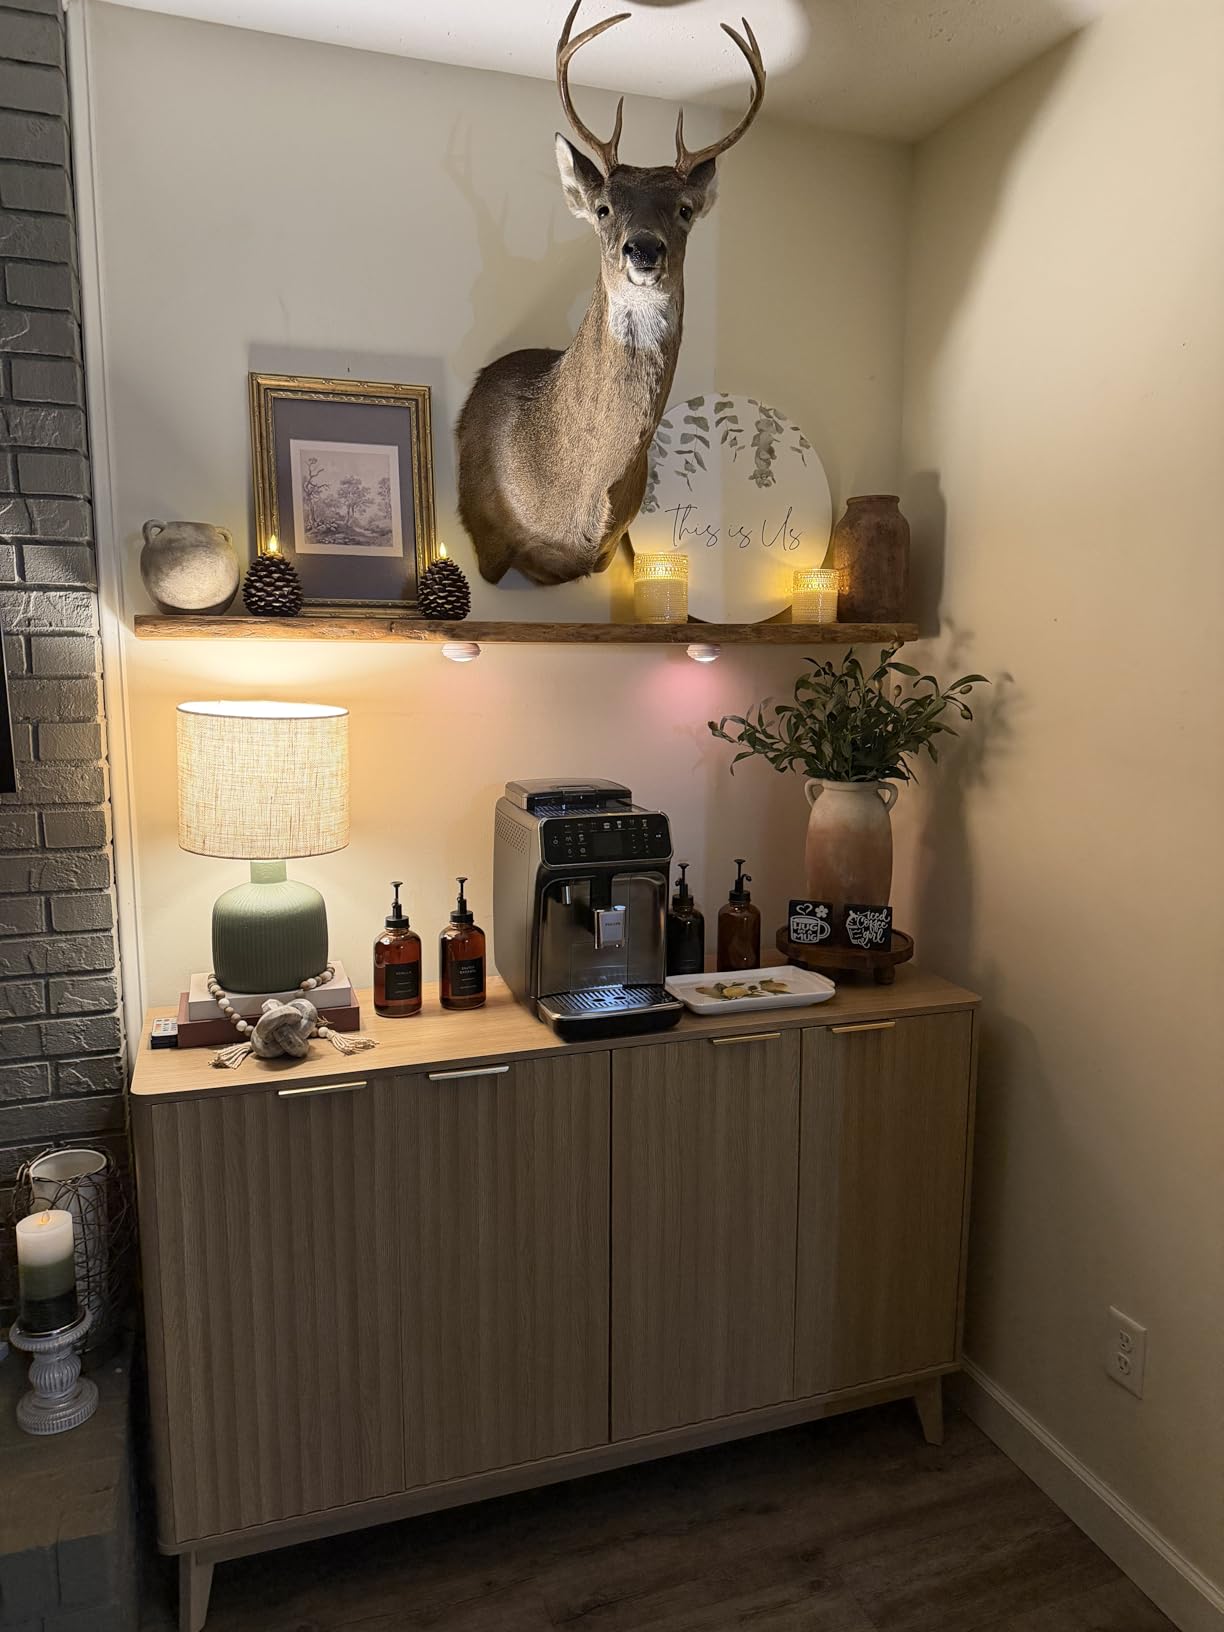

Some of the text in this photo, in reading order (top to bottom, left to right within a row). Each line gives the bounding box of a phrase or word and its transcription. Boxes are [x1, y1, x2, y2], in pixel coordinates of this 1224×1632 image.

[665, 503, 803, 551] This is Us
[793, 922, 818, 931] HUG
[793, 933, 817, 941] MUG
